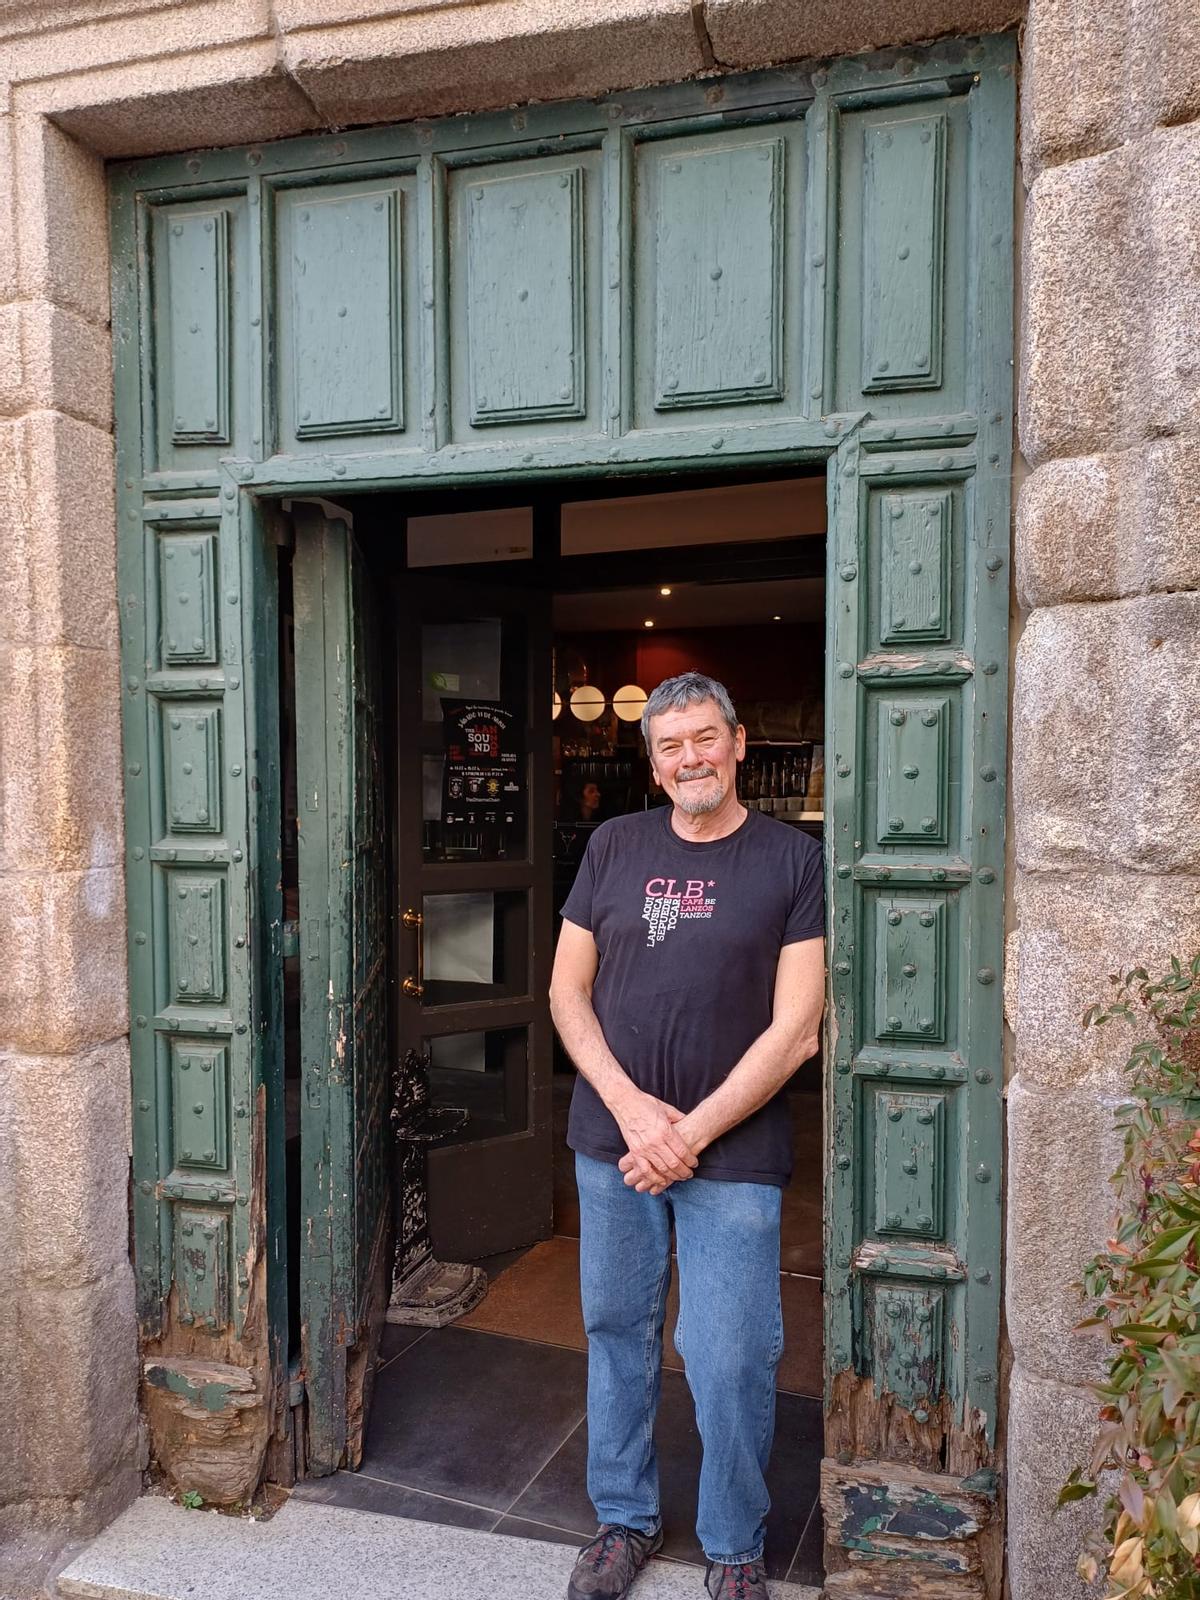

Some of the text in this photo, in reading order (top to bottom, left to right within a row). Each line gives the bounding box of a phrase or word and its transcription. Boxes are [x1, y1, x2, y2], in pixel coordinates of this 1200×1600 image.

[467, 733, 490, 743] SOU
[474, 743, 490, 752] ND
[666, 899, 681, 931] TOCAR
